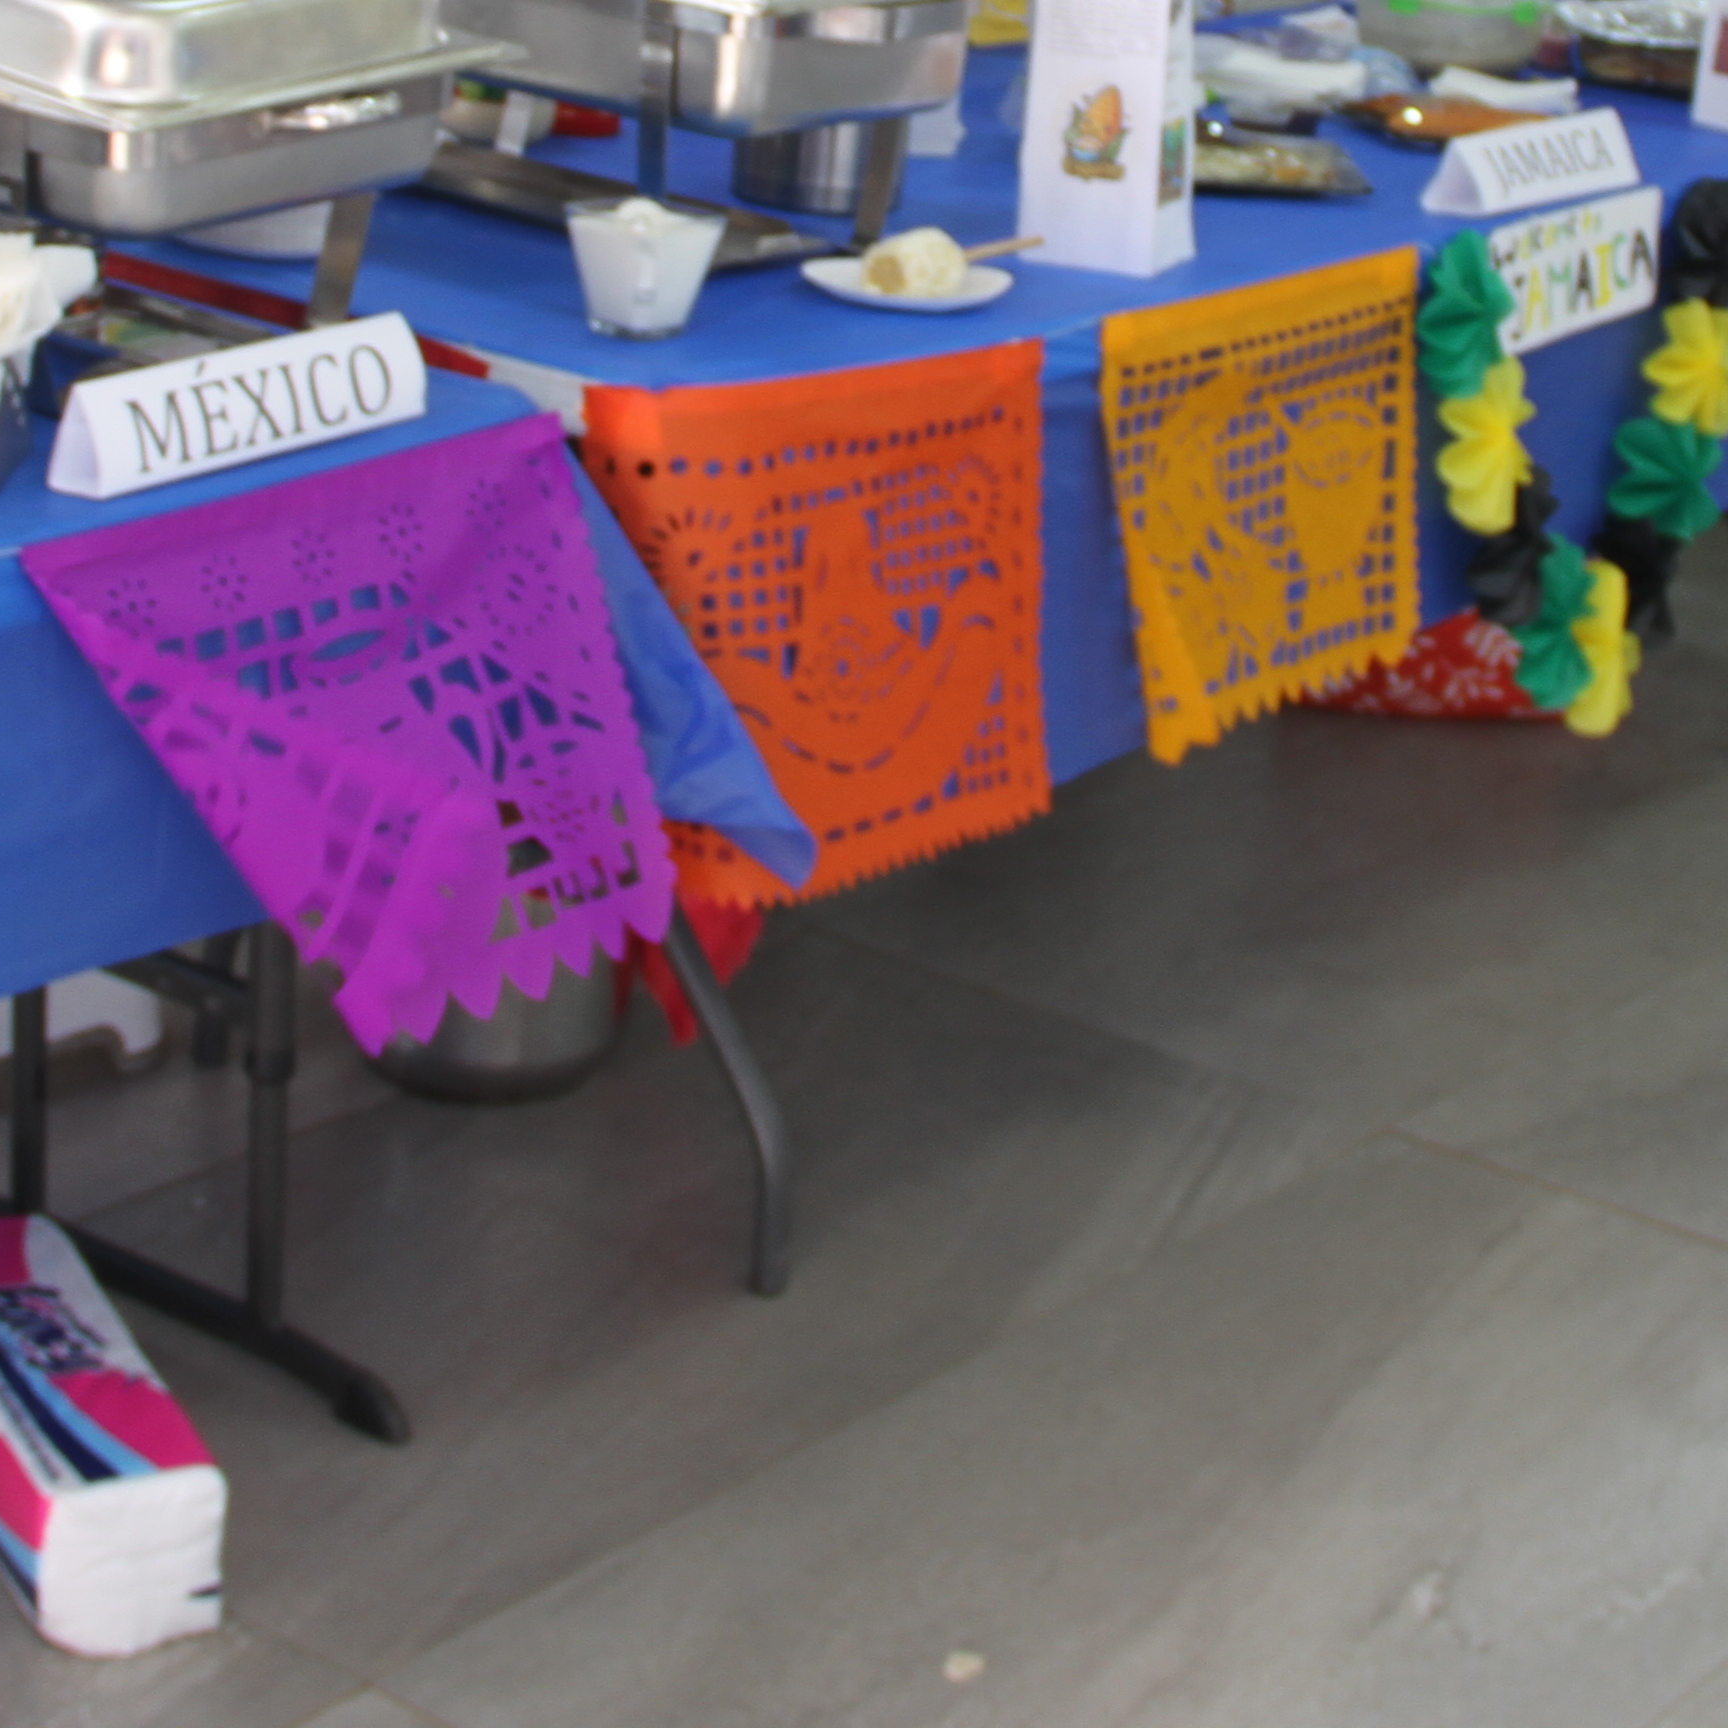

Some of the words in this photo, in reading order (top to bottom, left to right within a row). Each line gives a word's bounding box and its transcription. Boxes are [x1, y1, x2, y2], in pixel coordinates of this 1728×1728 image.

[1483, 127, 1616, 200] JAMAICA
[1509, 229, 1655, 341] JAMAICA
[125, 344, 391, 473] MÉXICO
